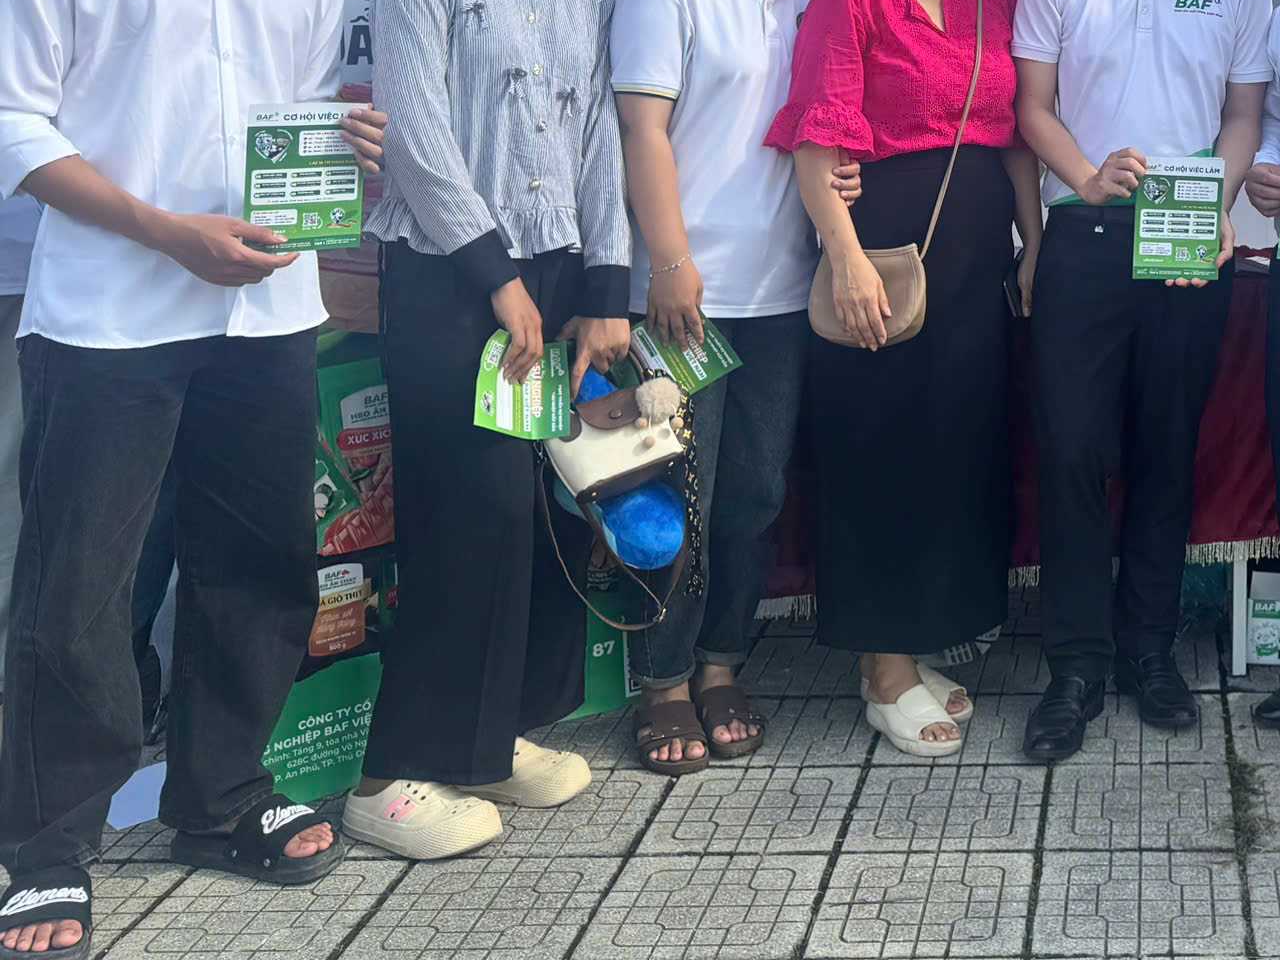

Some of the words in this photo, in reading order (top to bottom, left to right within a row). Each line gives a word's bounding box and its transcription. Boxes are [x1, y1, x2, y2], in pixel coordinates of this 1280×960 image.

[592, 640, 615, 658] 87
[298, 713, 334, 731] CÔNG
[336, 707, 352, 720] TY
[273, 729, 321, 752] NGHIỆP
[324, 721, 350, 737] BAF
[352, 713, 373, 728] VIỆ
[285, 770, 298, 780] An
